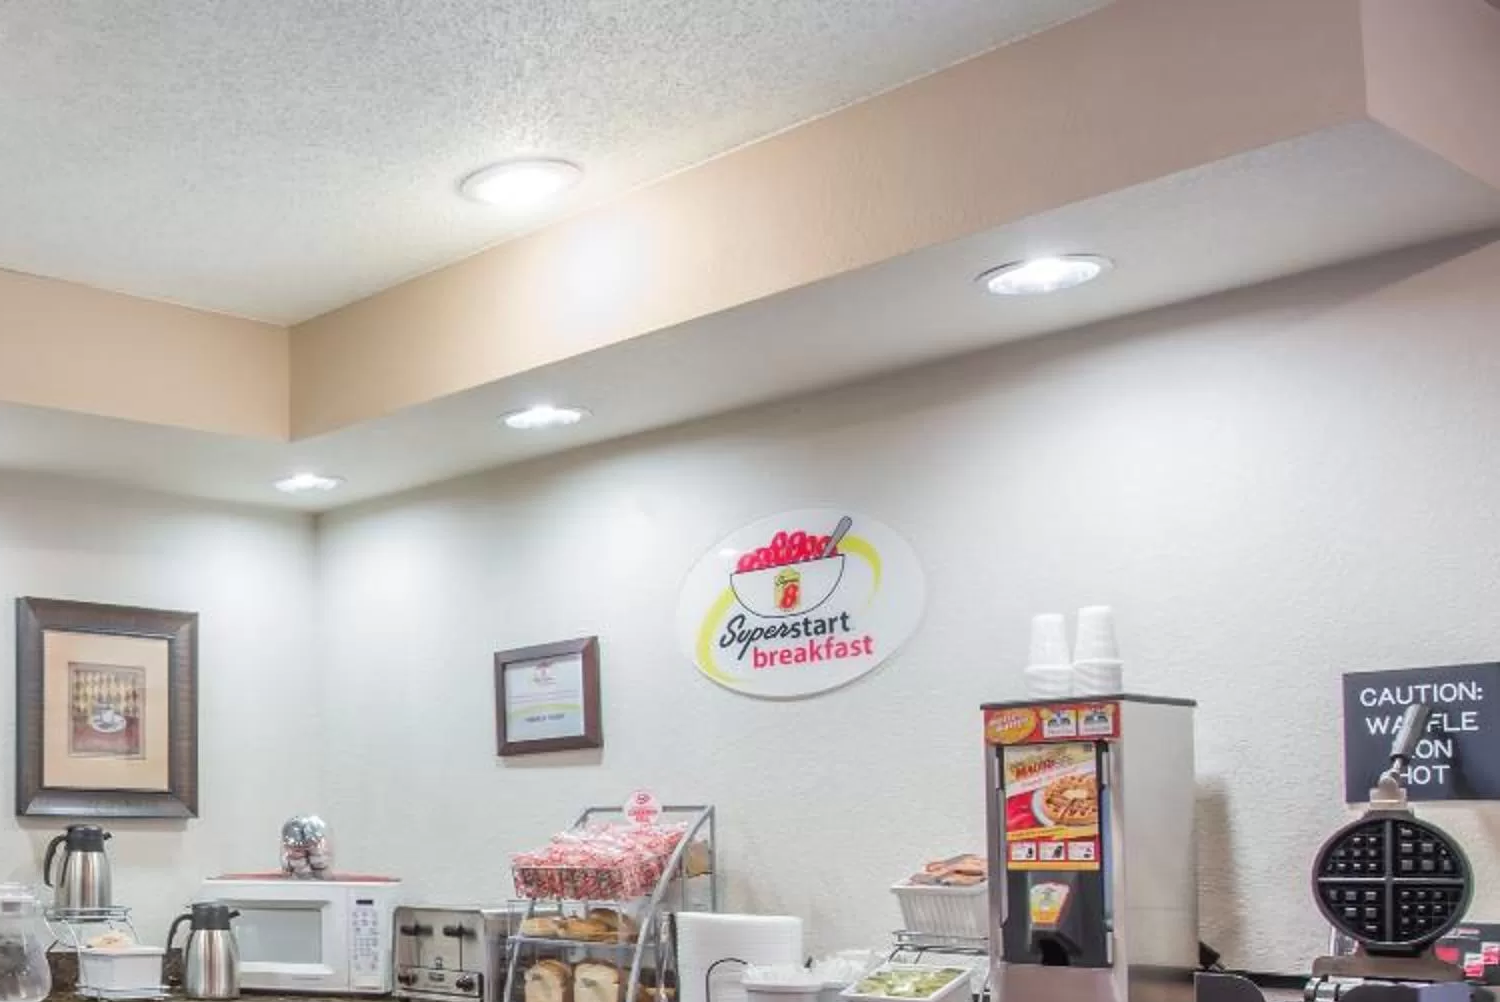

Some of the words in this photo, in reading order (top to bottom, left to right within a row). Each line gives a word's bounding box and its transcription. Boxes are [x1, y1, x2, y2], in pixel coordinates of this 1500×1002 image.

[719, 611, 850, 660] Superstart
[753, 635, 873, 668] breakfast
[1359, 681, 1484, 707] CAUTION:
[1365, 711, 1479, 736] WAFLE
[1411, 738, 1453, 759] ON
